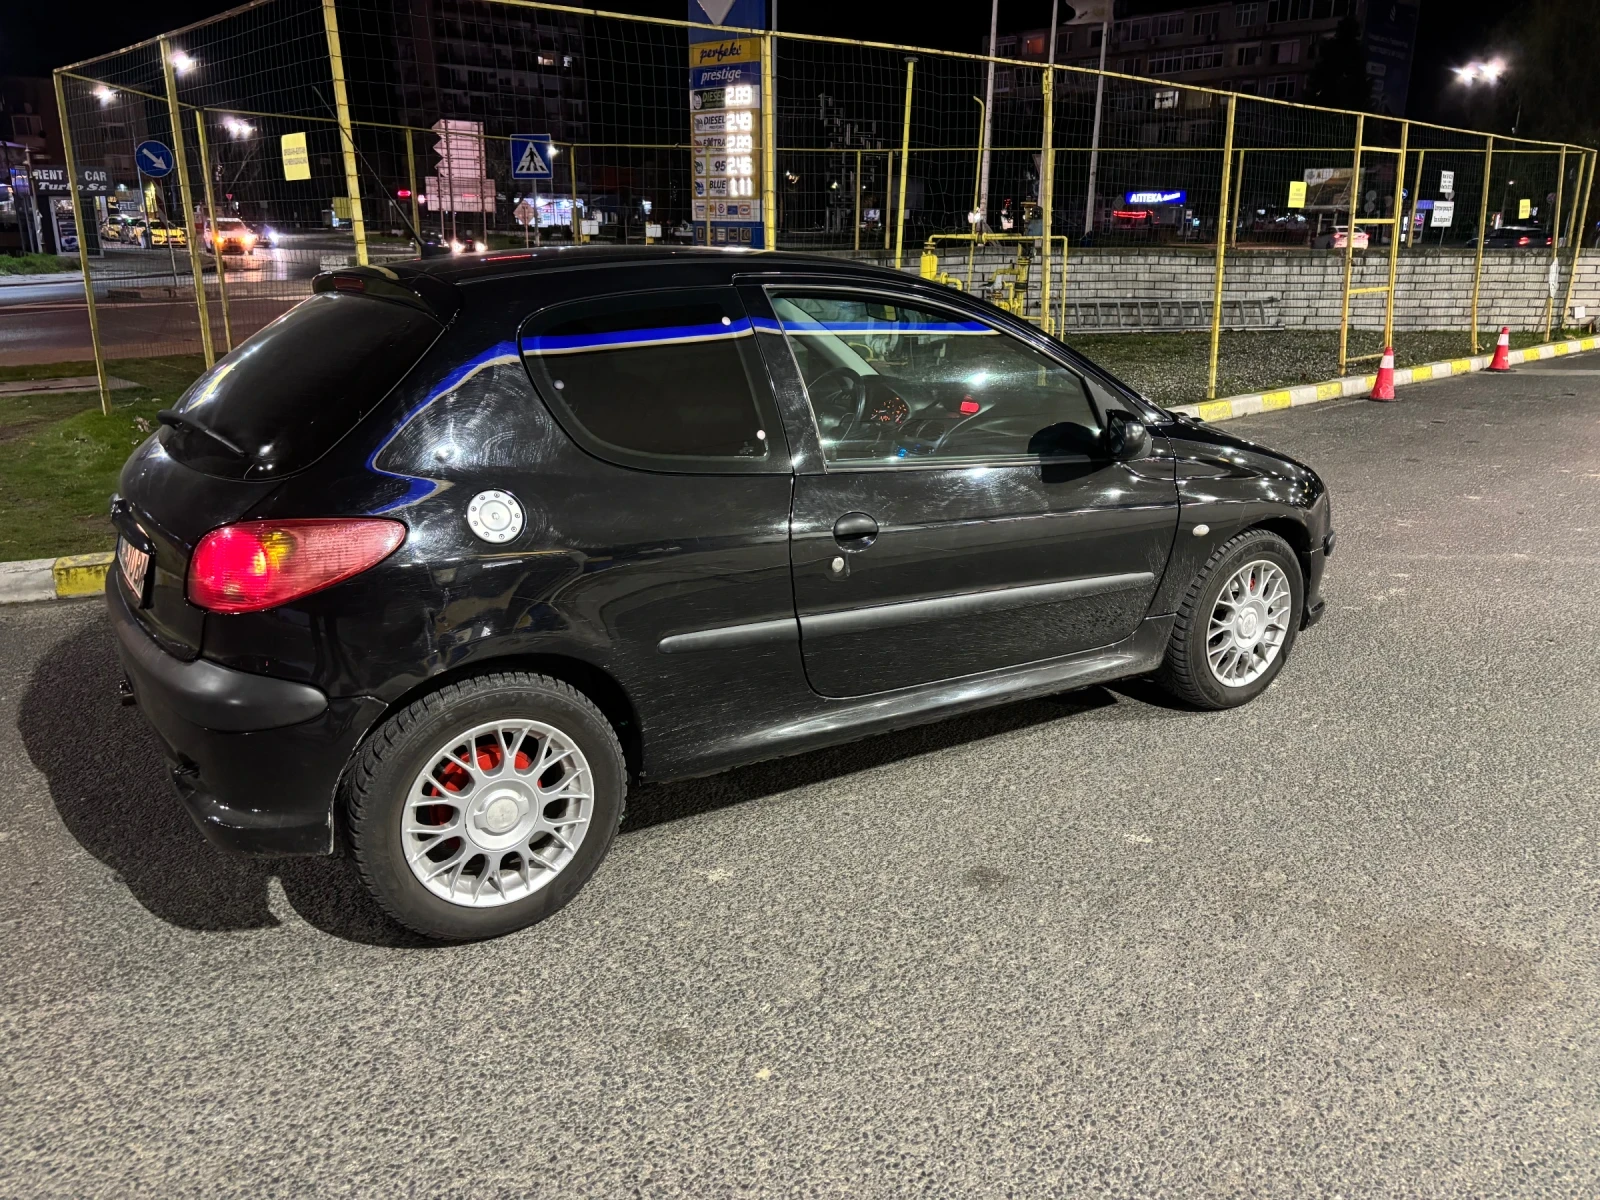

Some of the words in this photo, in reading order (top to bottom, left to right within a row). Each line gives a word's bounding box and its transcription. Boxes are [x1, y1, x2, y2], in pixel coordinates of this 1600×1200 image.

[700, 42, 742, 63] perfekt
[701, 67, 742, 85] prestige
[704, 115, 726, 125] DIESEL
[714, 160, 726, 172] 95
[35, 169, 64, 180] RENT
[84, 170, 108, 181] CAR
[709, 180, 726, 189] BLUE
[1130, 192, 1163, 203] АПТЕКА
